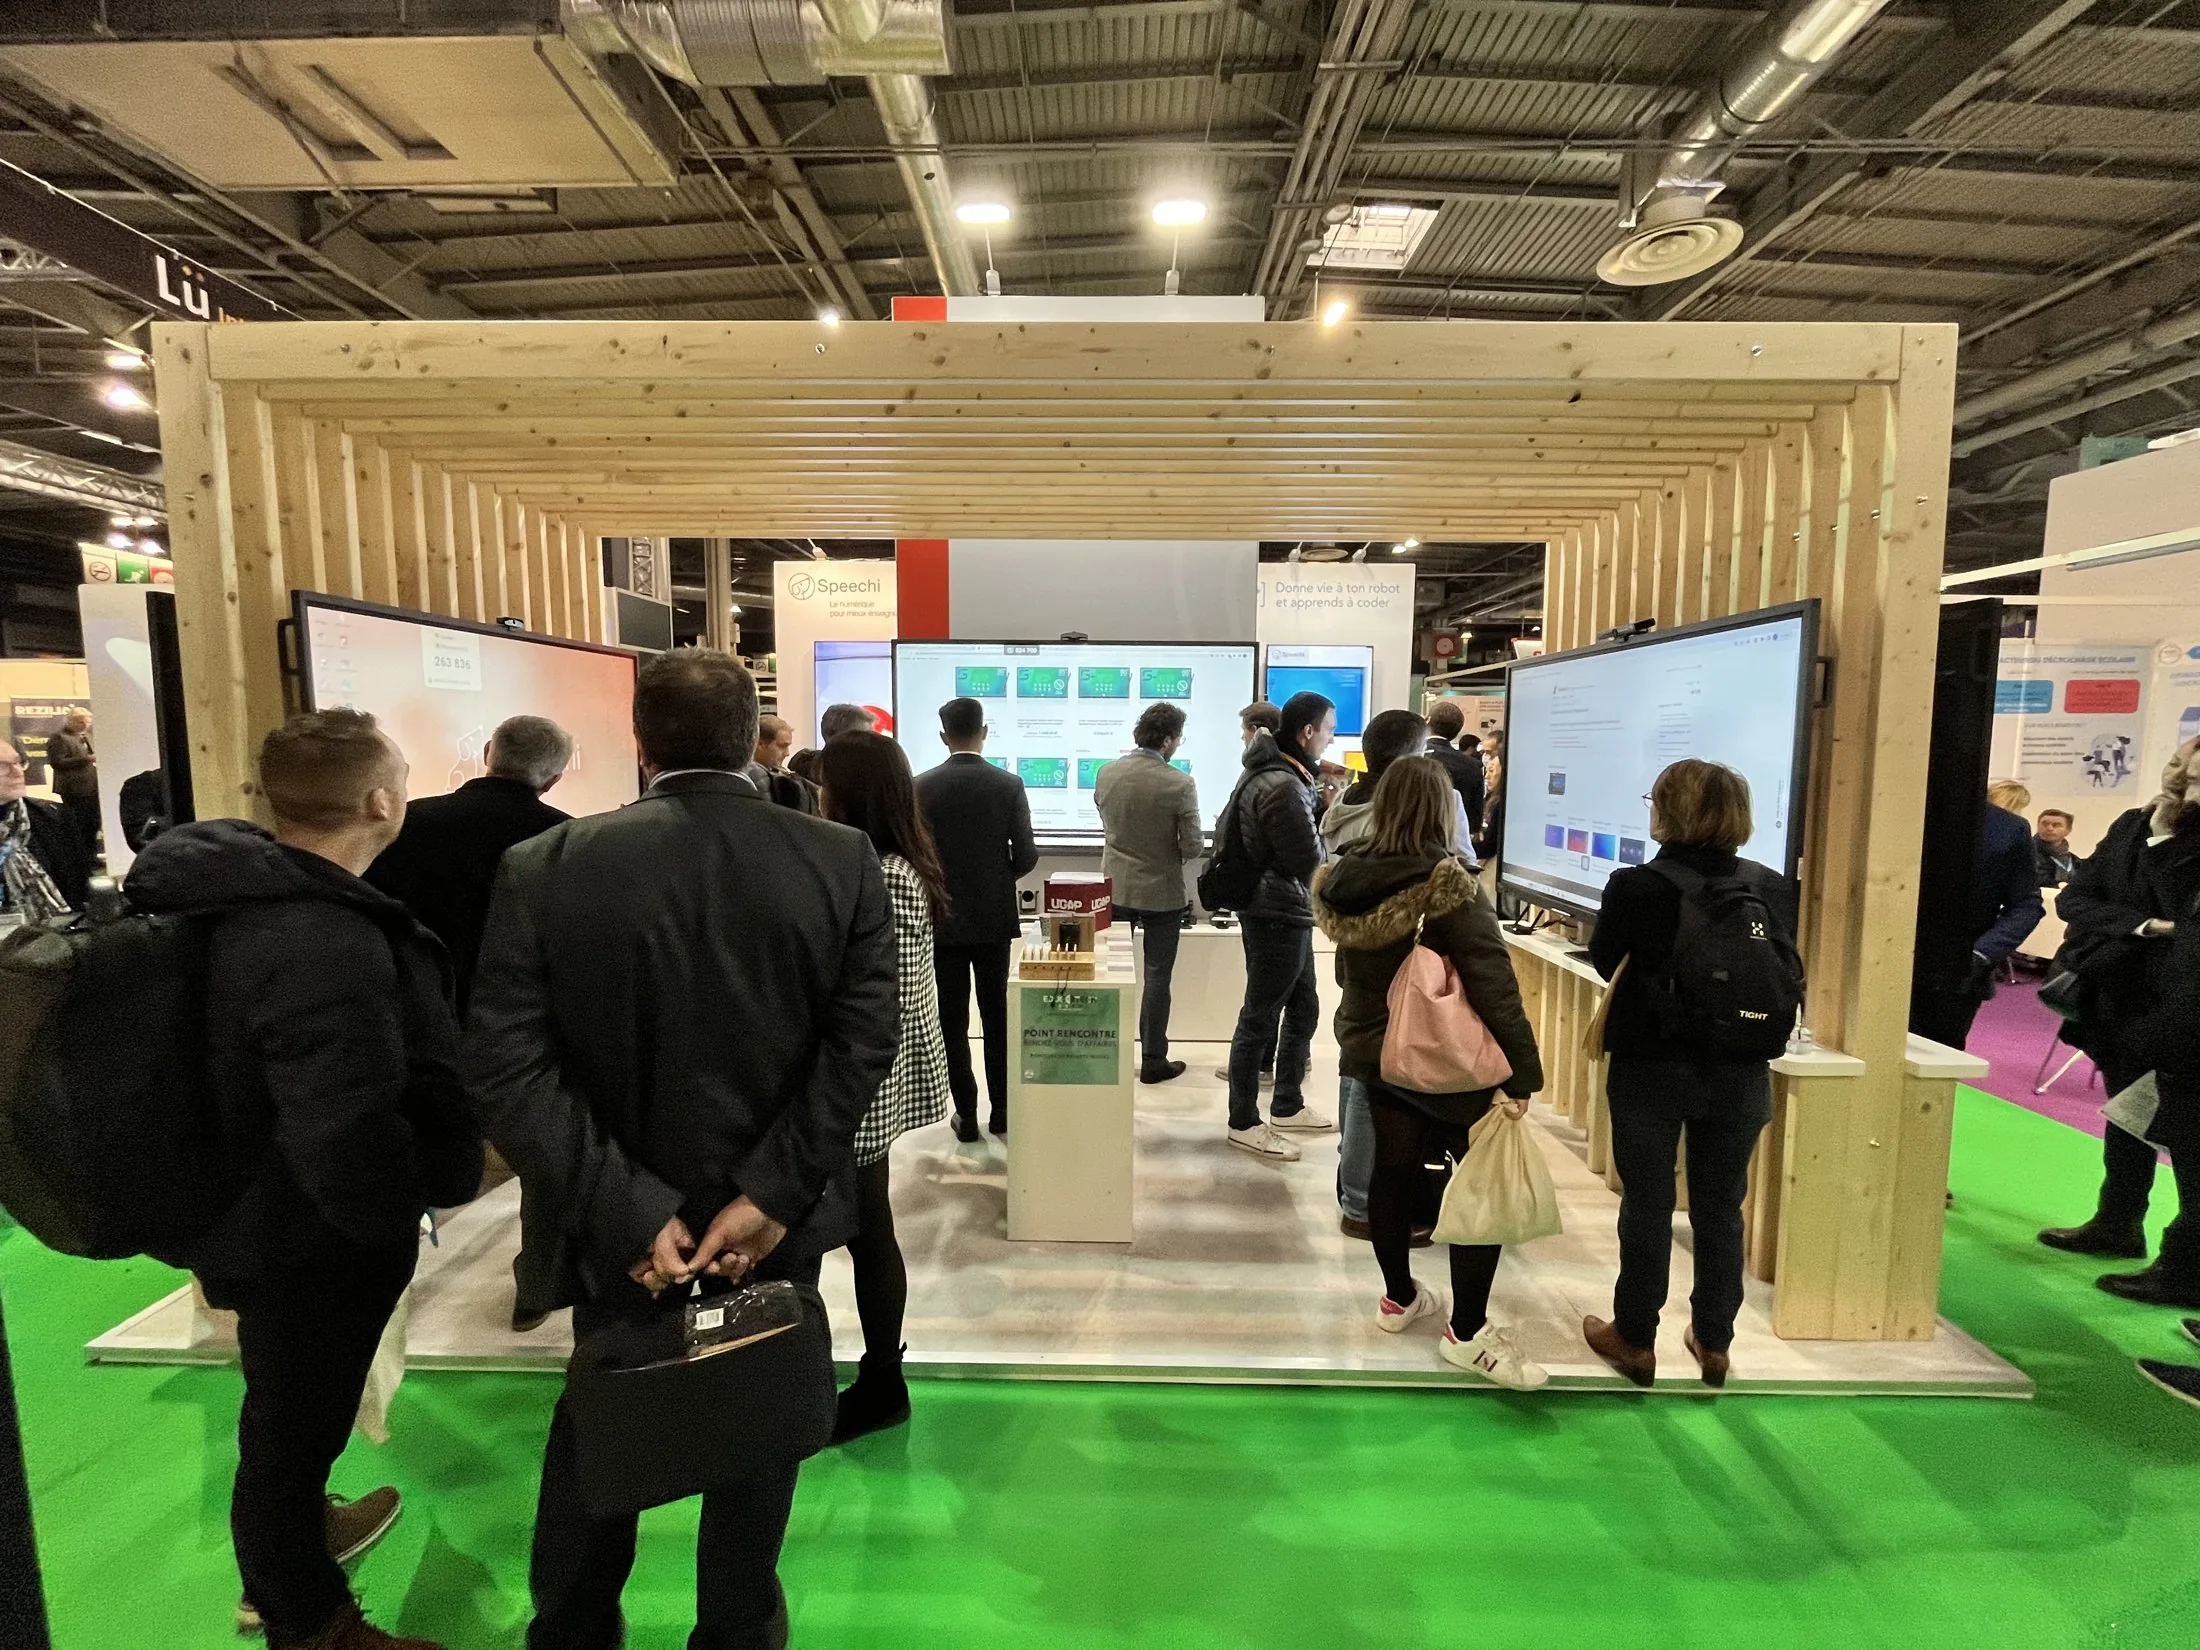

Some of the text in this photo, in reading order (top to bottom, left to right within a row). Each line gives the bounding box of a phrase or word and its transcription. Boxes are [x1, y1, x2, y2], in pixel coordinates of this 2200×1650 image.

[156, 254, 210, 319] Lü
[817, 578, 881, 595] Speechi
[1275, 582, 1400, 594] Donne vie à ton robot
[840, 600, 875, 609] numérique
[1275, 597, 1390, 610] et apprends à coder
[434, 655, 471, 670] 263 836
[1051, 898, 1082, 910] UGAP
[1091, 895, 1111, 910] UGAP
[1739, 1010, 1768, 1021] TIGHT
[1024, 1029, 1117, 1039] POINT RENCONTRE
